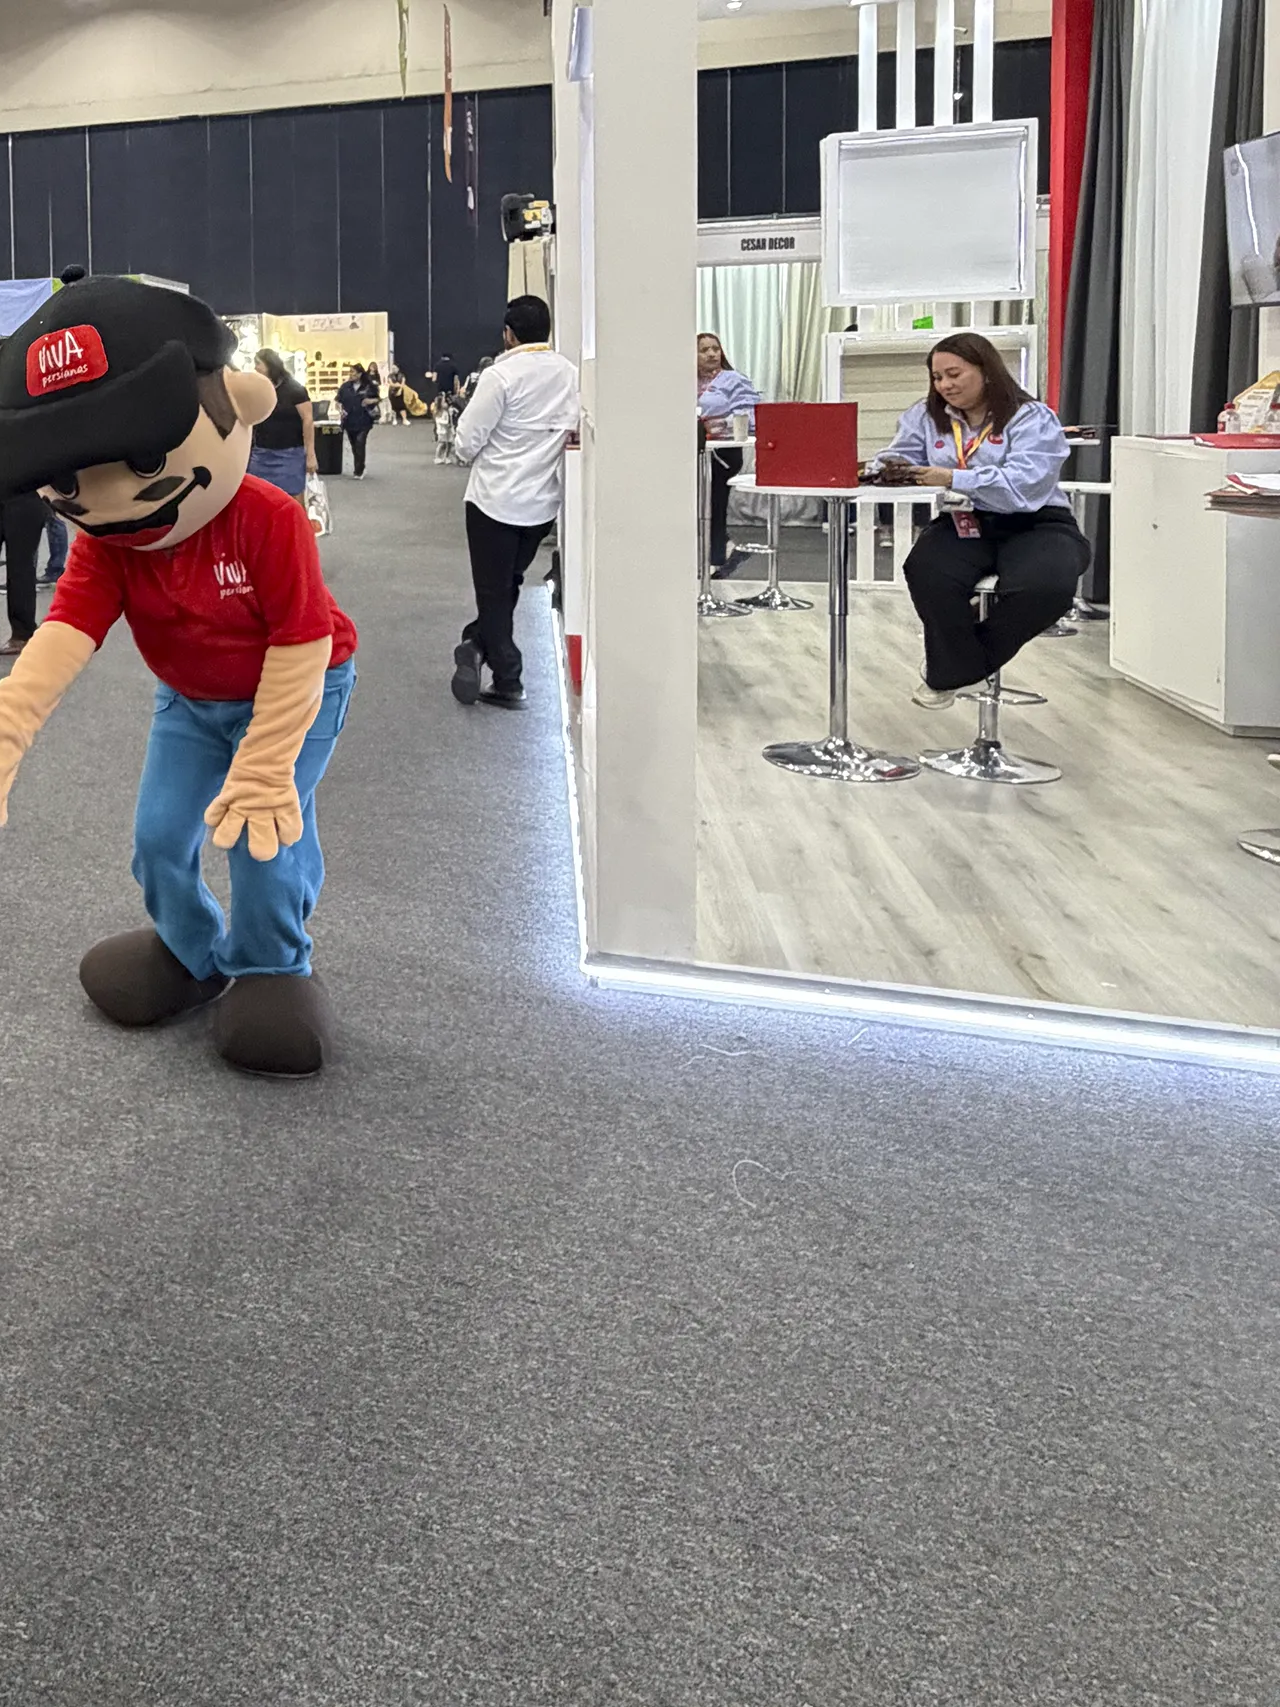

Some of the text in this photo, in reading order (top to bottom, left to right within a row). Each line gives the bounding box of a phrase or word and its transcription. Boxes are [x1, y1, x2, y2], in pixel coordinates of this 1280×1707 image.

[741, 236, 795, 251] CESAR DECOR
[42, 364, 89, 388] persianas
